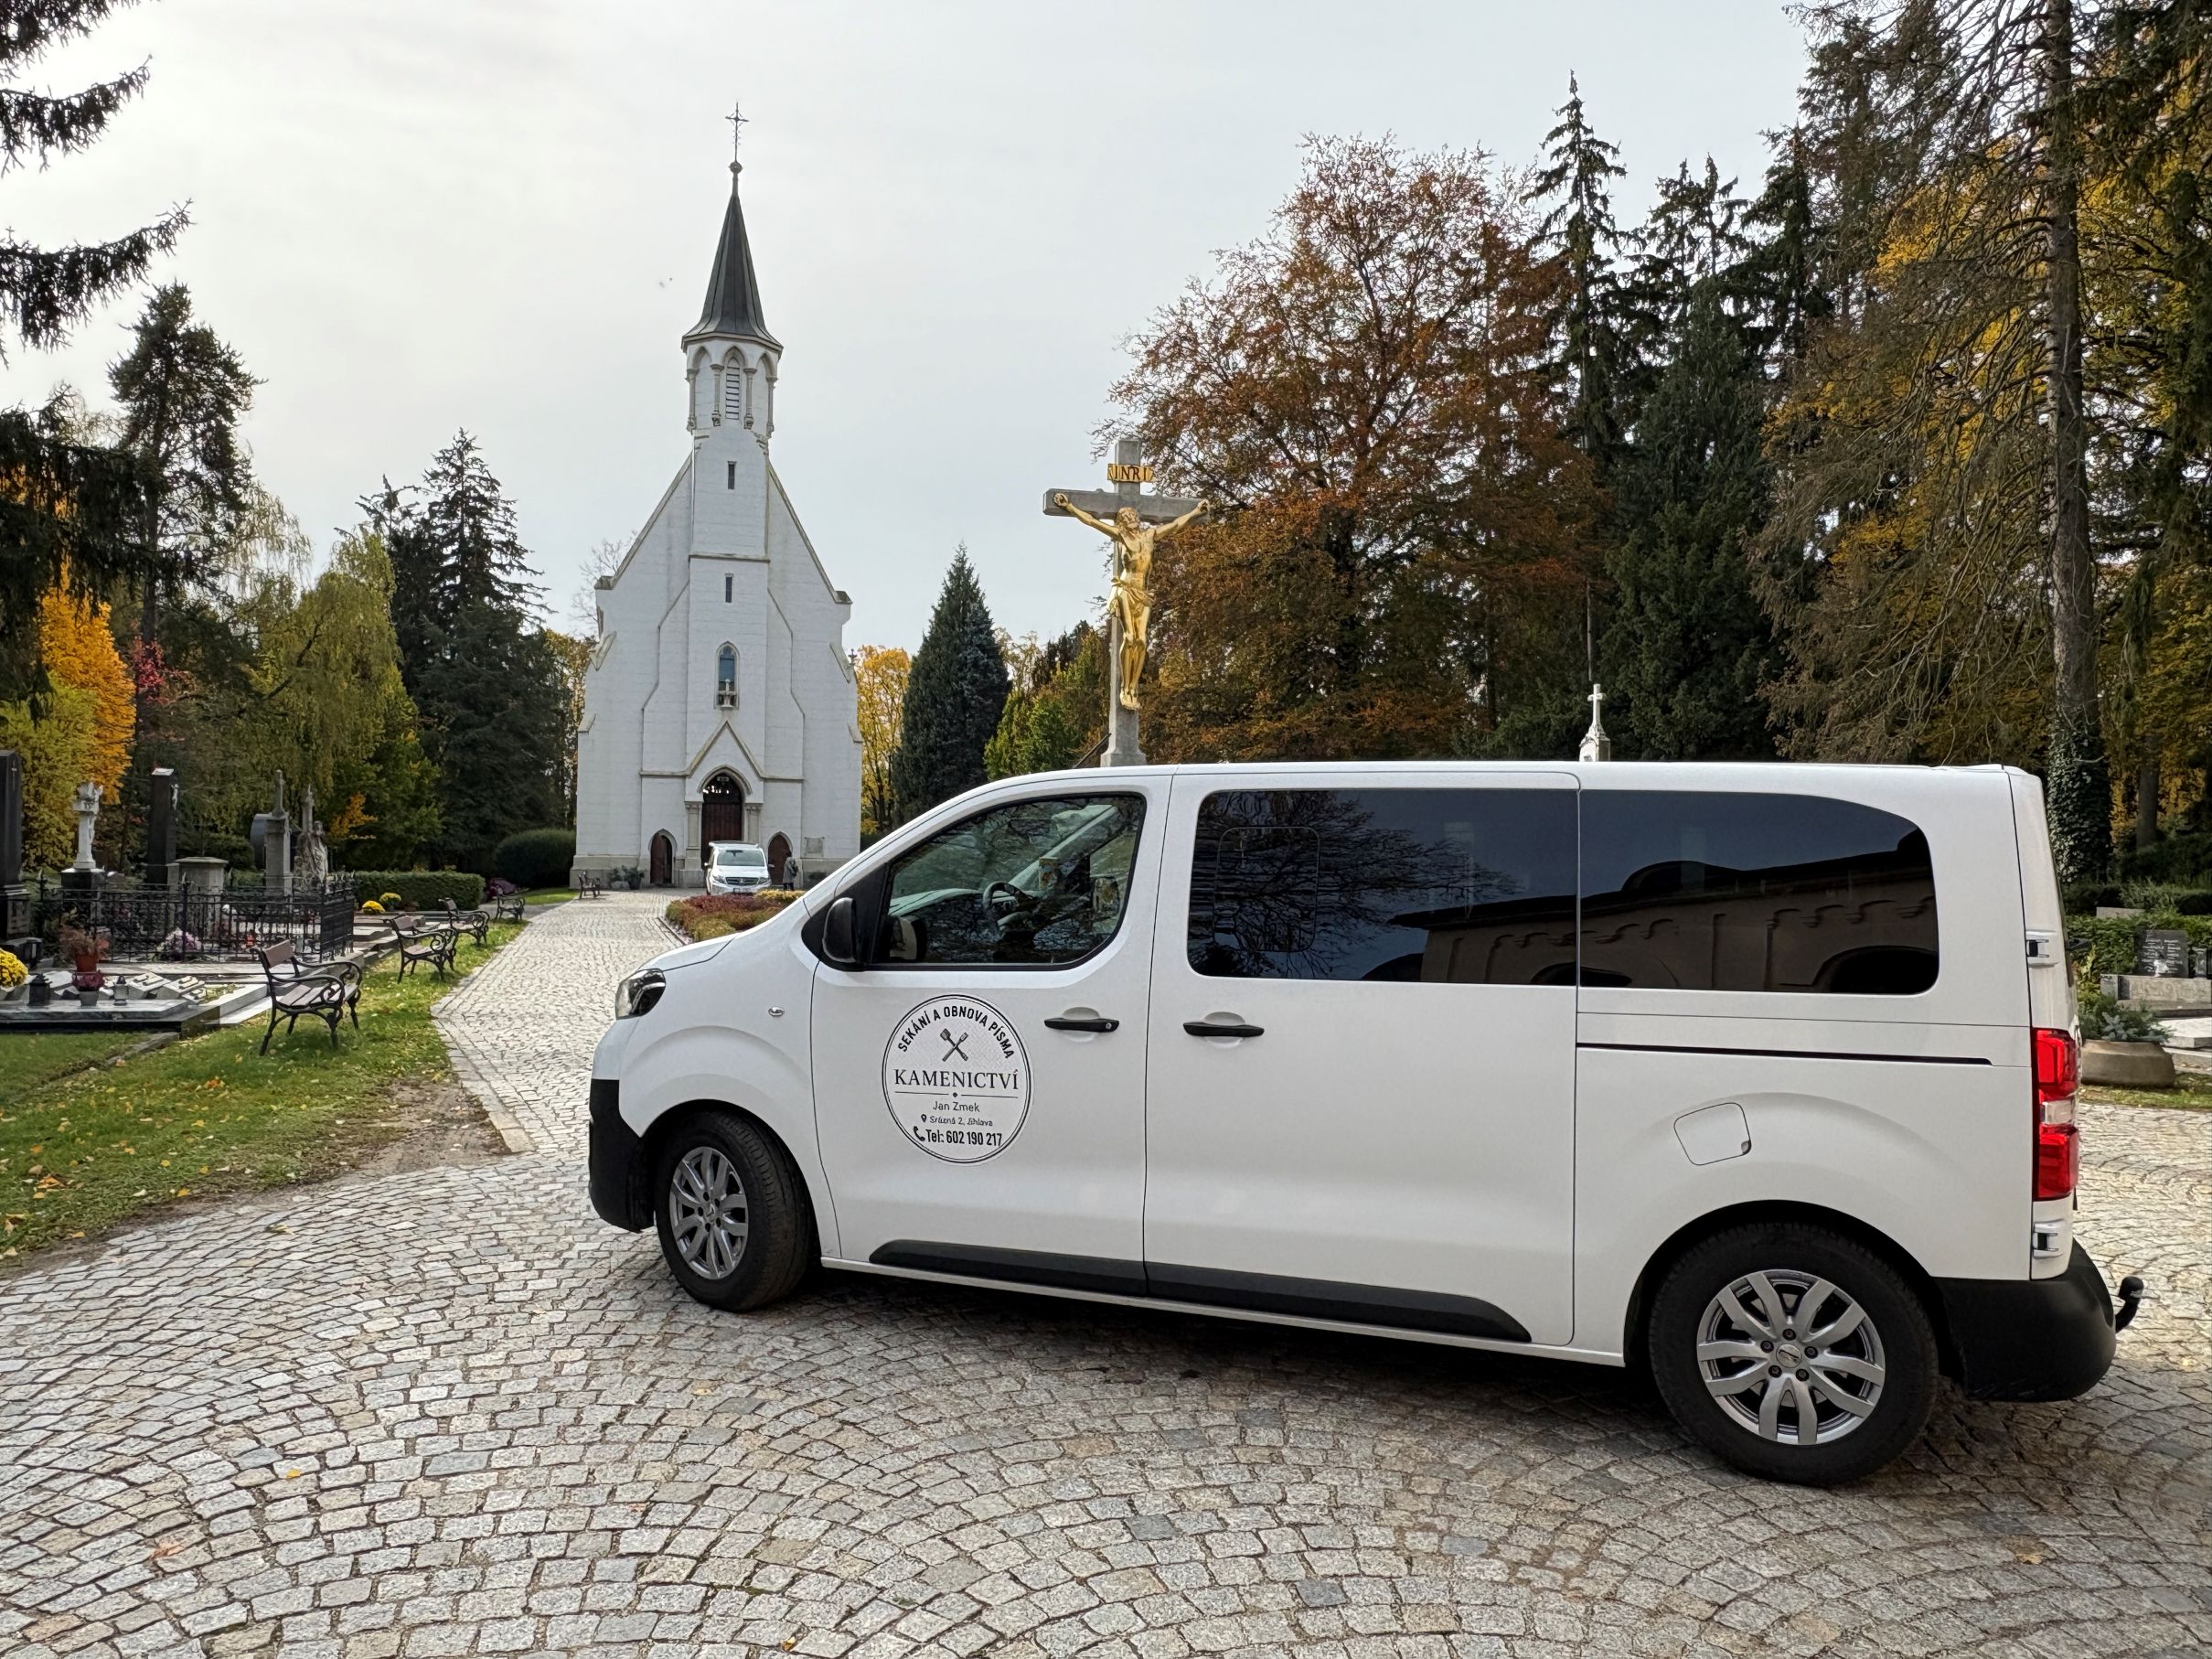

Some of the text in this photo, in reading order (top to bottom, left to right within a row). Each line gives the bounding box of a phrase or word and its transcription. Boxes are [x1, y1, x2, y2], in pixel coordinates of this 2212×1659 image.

[1115, 466, 1148, 480] INRI
[898, 1006, 1015, 1059] SEKÁNÍ A OBNOVA PÍSMA
[893, 1068, 1019, 1089] KAMENICTVÍ
[933, 1101, 980, 1112] Jan Zmek
[946, 1130, 965, 1144] 602
[967, 1132, 984, 1145] 190
[986, 1133, 1002, 1146] 217
